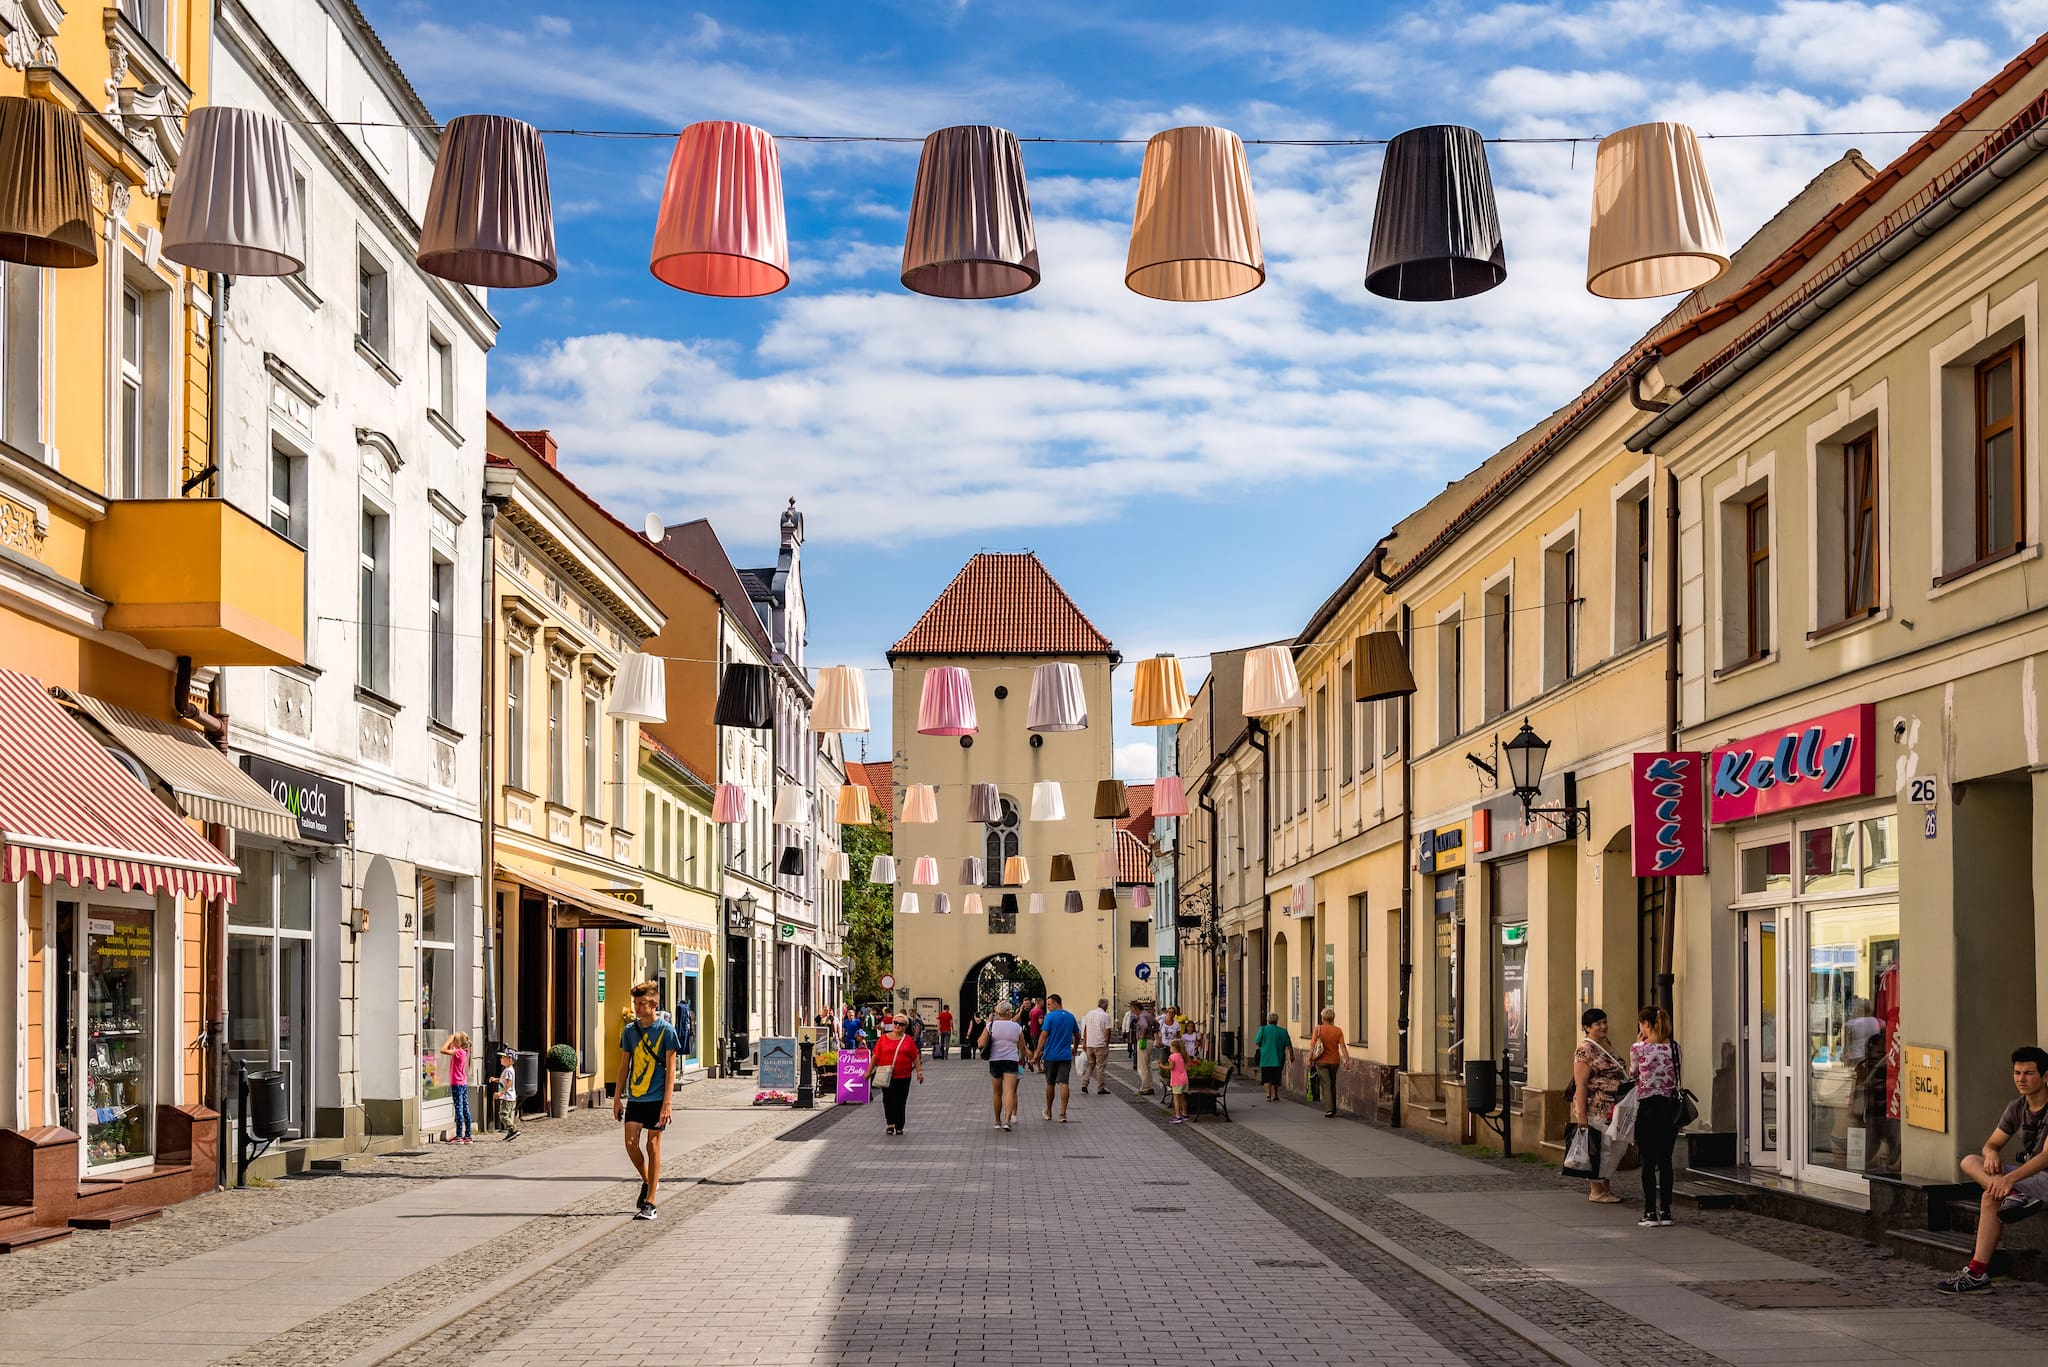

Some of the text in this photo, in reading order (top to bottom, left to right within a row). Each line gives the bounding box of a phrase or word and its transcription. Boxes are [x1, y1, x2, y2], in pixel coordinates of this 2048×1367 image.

[1714, 725, 1855, 799] Kelly
[1911, 779, 1935, 801] 26
[301, 816, 328, 833] fashion house
[1925, 814, 1935, 836] 26
